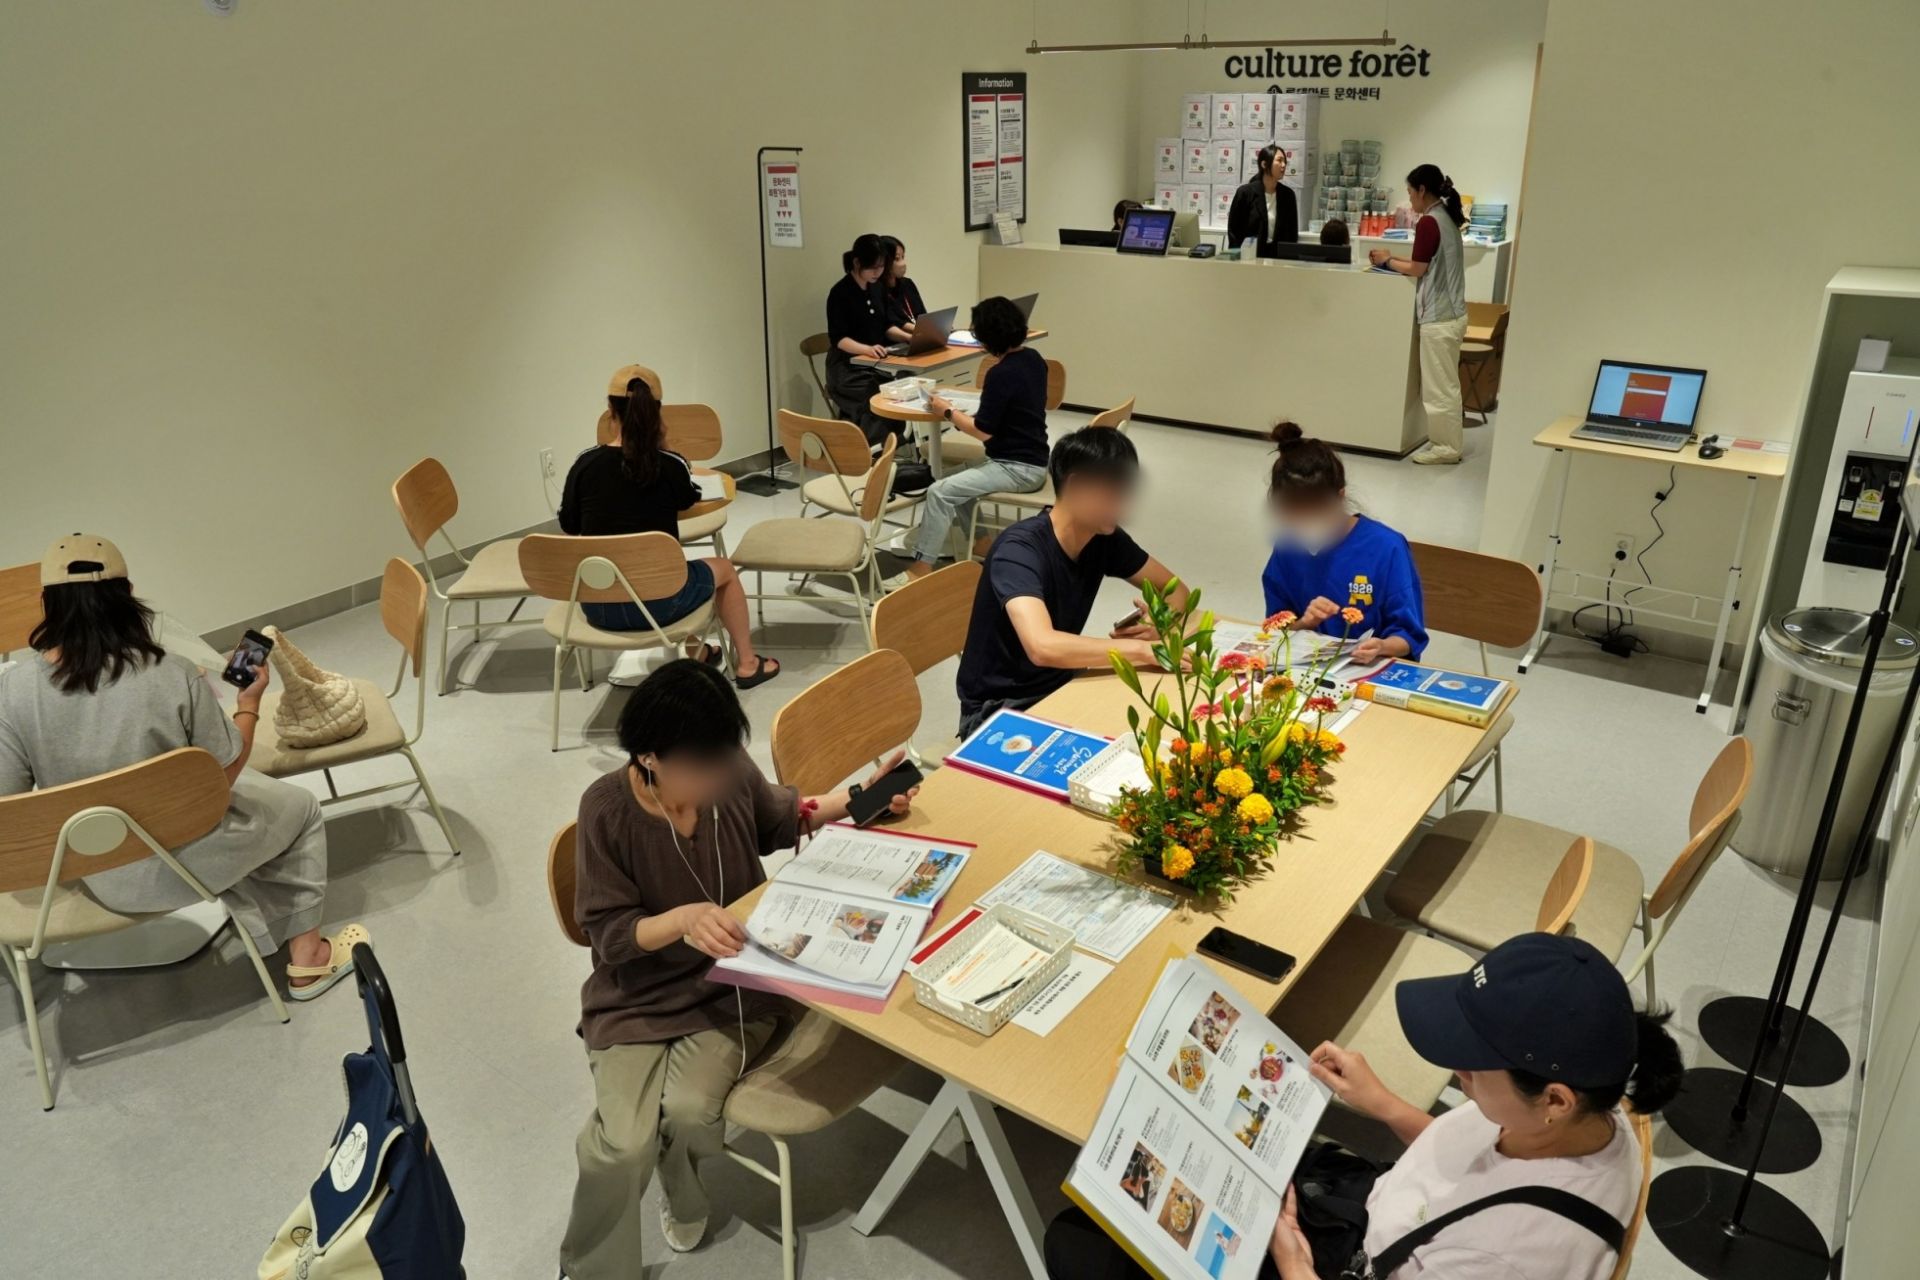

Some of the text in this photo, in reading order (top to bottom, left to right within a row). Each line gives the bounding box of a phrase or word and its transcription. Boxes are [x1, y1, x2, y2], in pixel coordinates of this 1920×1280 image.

[1224, 44, 1431, 79] culture forêt
[978, 77, 1014, 88] Information
[1334, 87, 1380, 100] 문화센터
[1348, 582, 1374, 594] 1928
